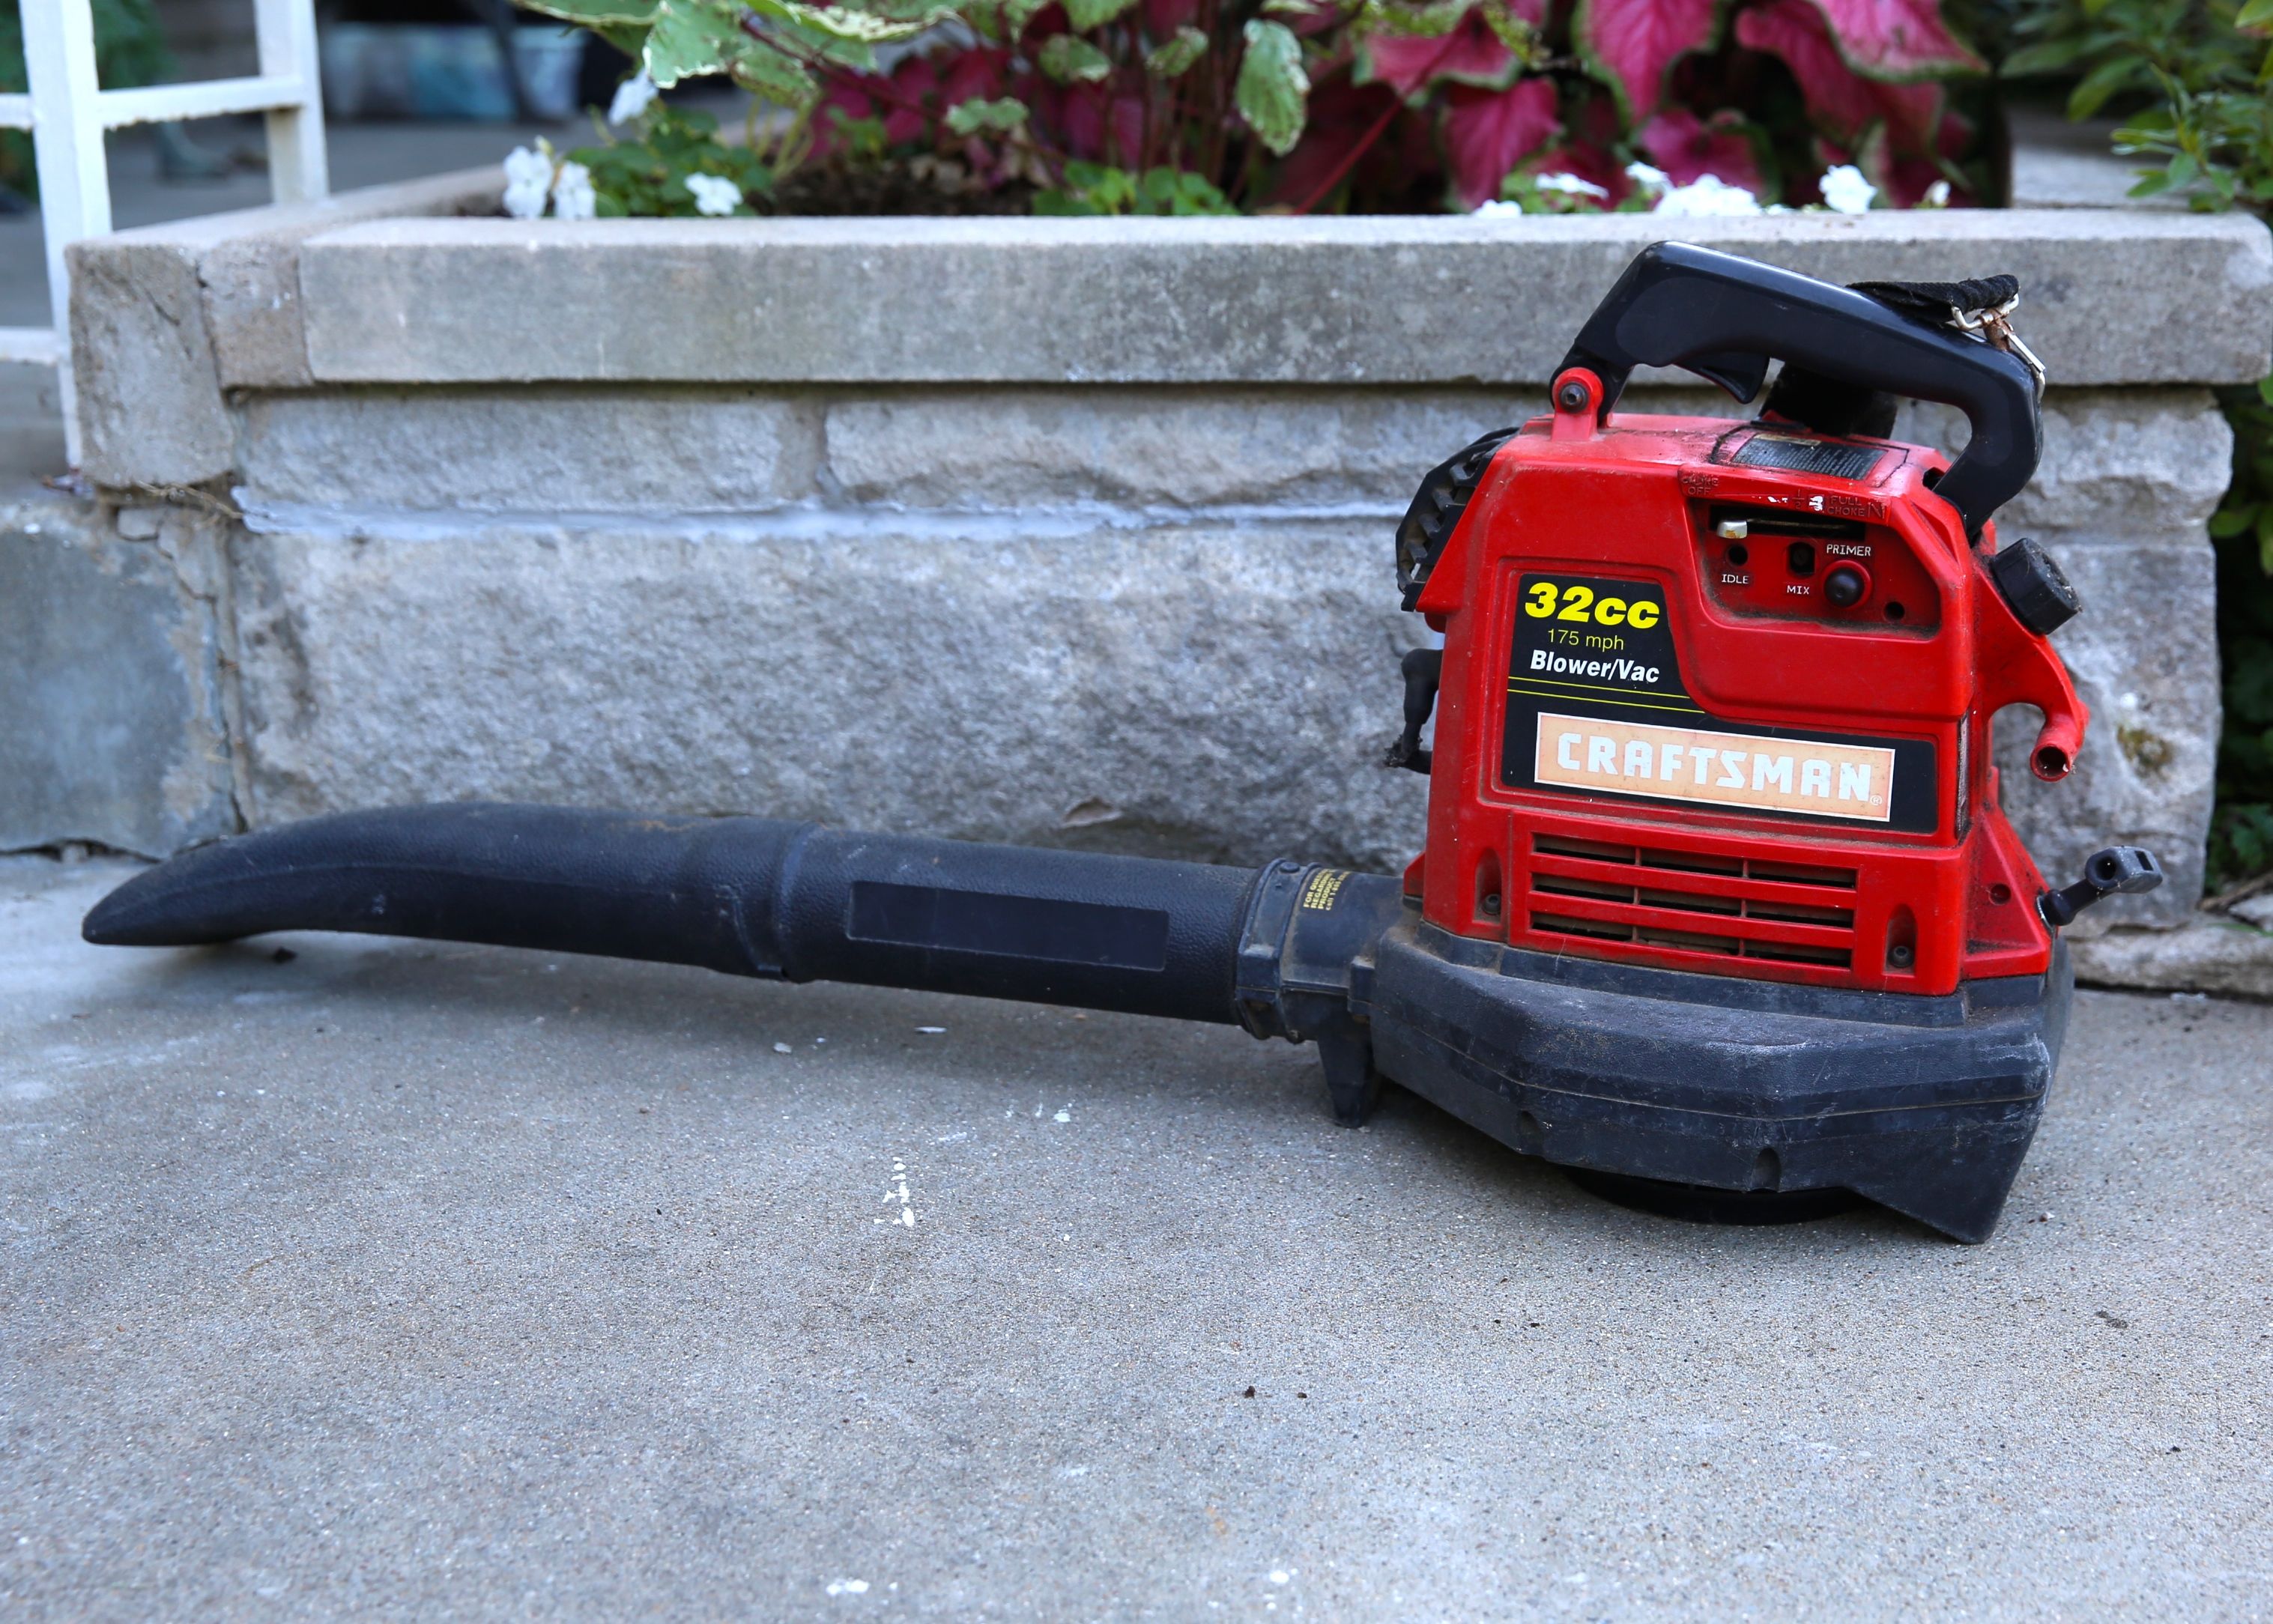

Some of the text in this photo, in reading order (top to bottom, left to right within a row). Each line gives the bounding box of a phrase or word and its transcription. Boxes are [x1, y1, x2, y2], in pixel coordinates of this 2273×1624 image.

[1687, 486, 1712, 495] OFF
[1830, 495, 1862, 506] FULL
[1827, 506, 1866, 517] CHOKE
[1826, 544, 1871, 557] PRIMER
[1721, 574, 1749, 585] IDLE
[1786, 584, 1810, 596] MIX
[1524, 582, 1660, 629] 32cc
[1547, 628, 1624, 652] 175 mph
[1530, 649, 1660, 684] Blower/Vac
[1557, 732, 1871, 802] CRAFTSMAN
[1303, 891, 1314, 908] FOR
[1318, 878, 1336, 909] PRODUCT
